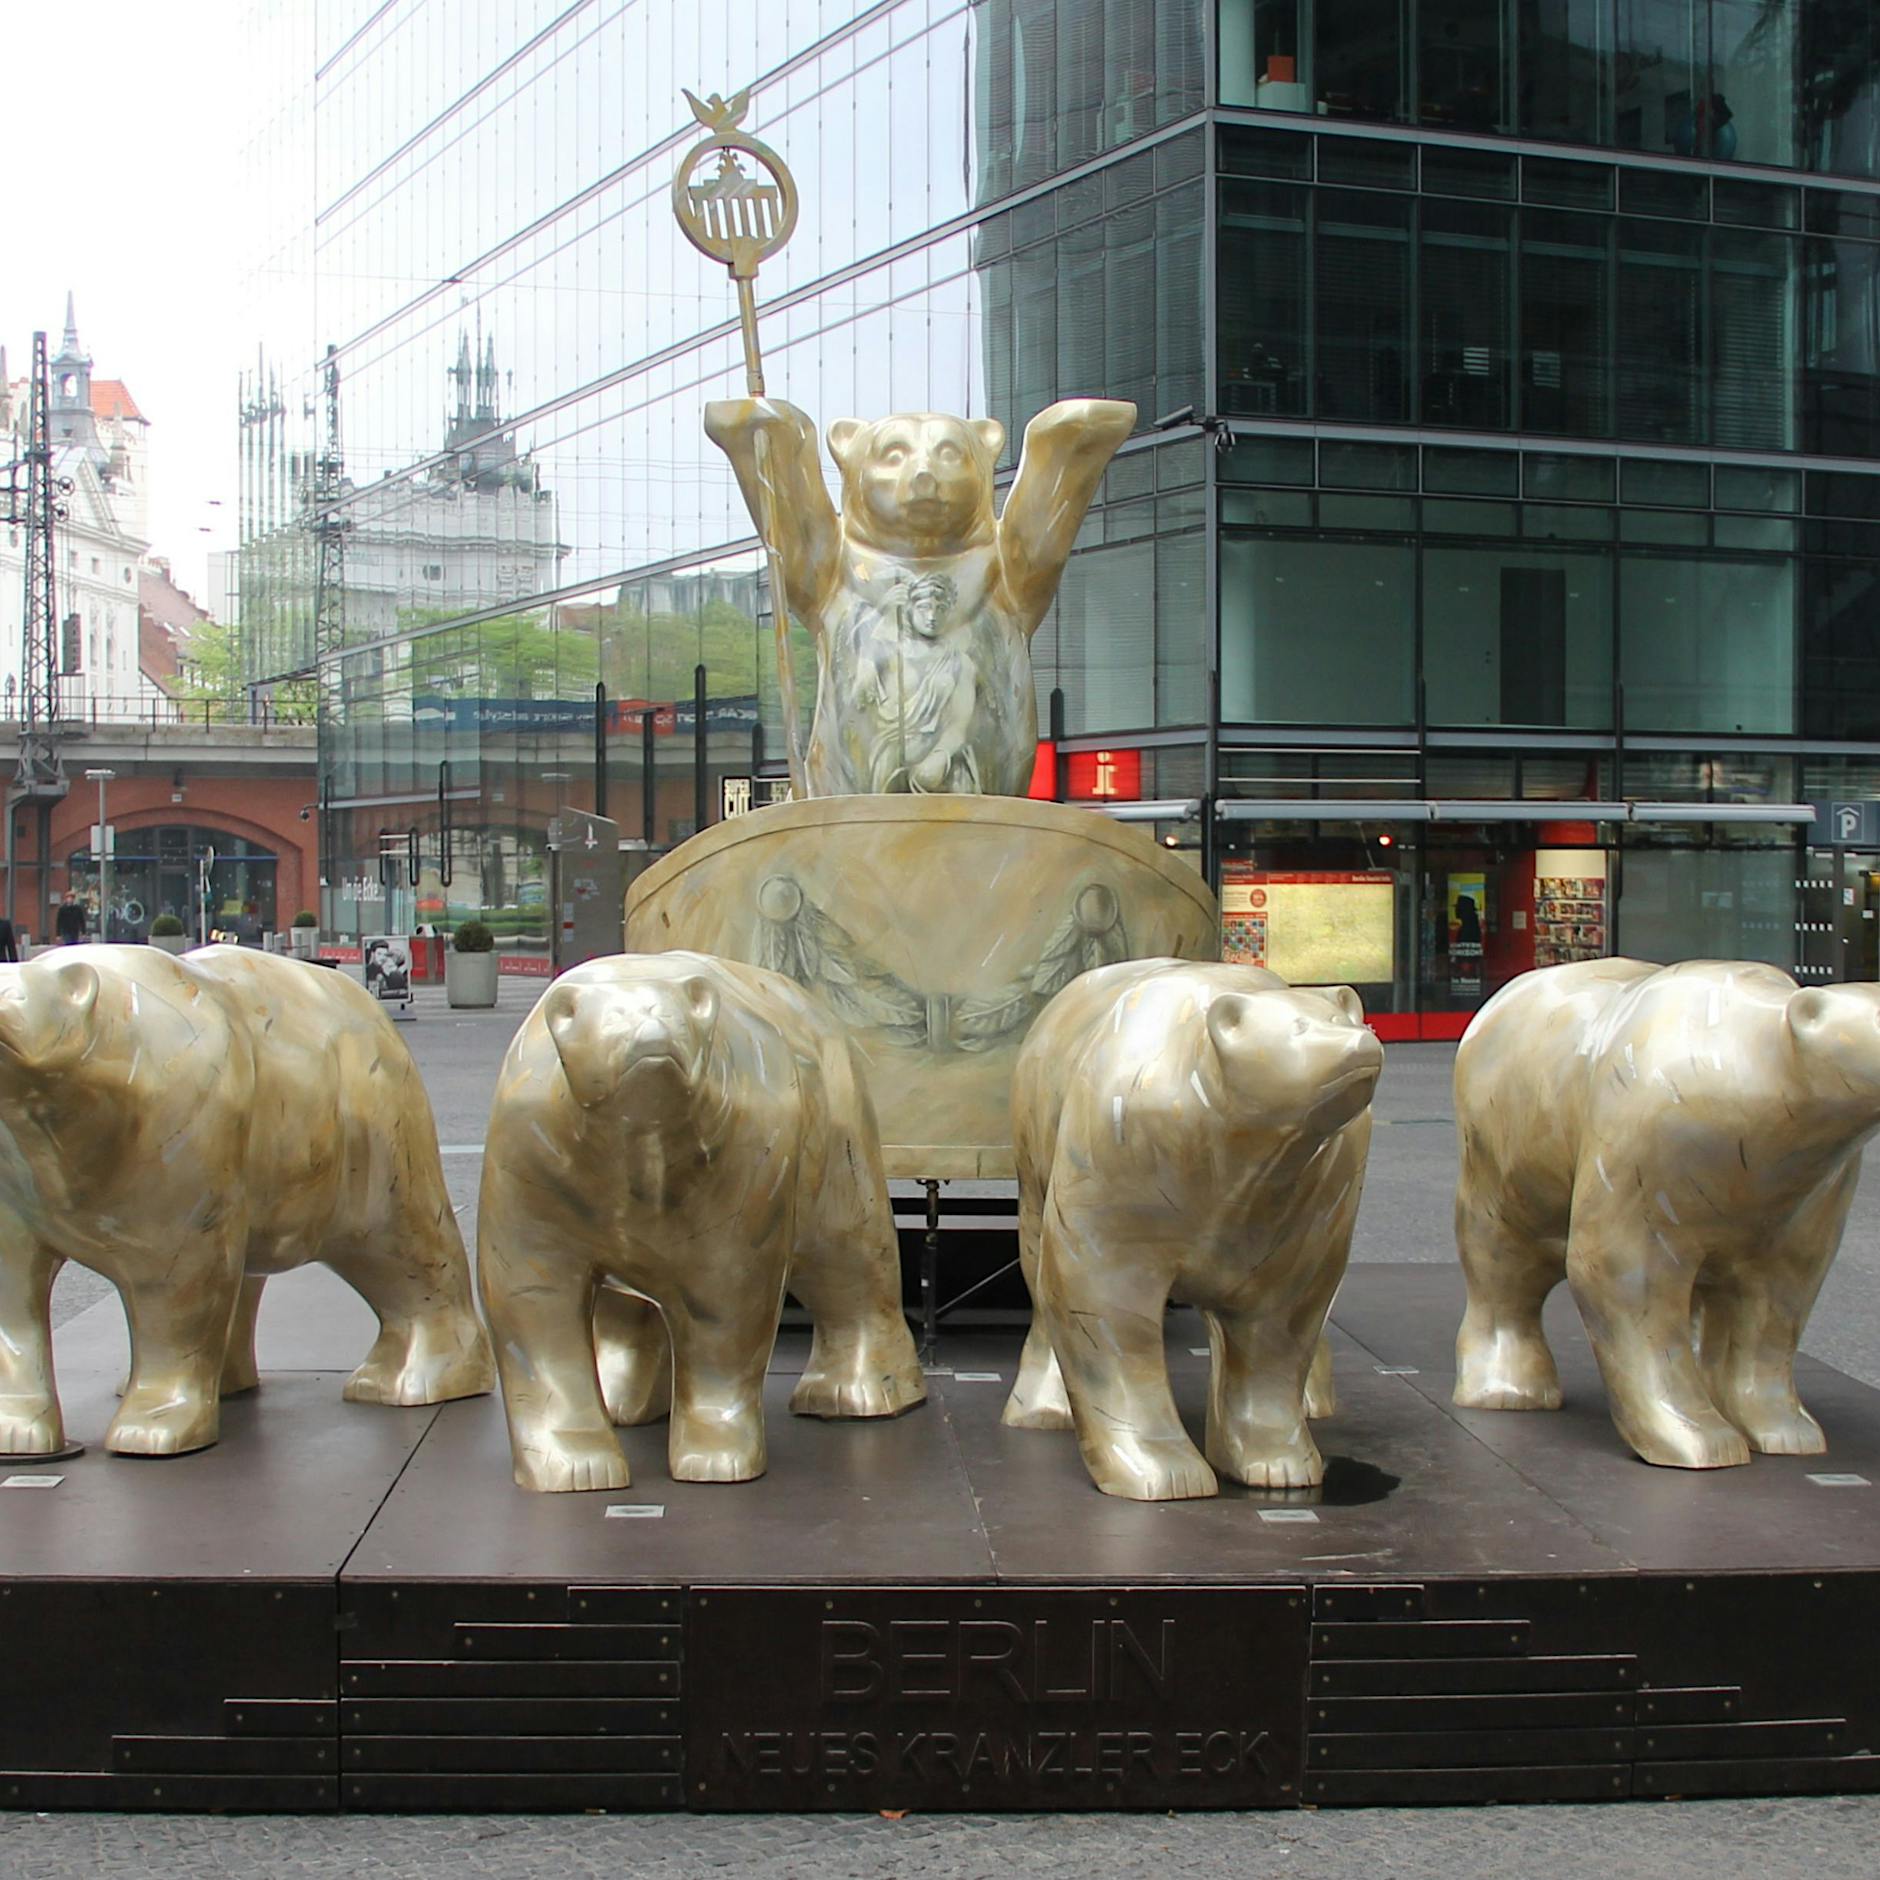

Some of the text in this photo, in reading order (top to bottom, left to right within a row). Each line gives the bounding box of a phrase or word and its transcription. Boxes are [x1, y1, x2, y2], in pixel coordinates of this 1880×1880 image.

[1841, 814, 1857, 838] P
[820, 1619, 1175, 1702] BERLIN
[720, 1731, 1271, 1777] NEUES KRANZLER ECK
